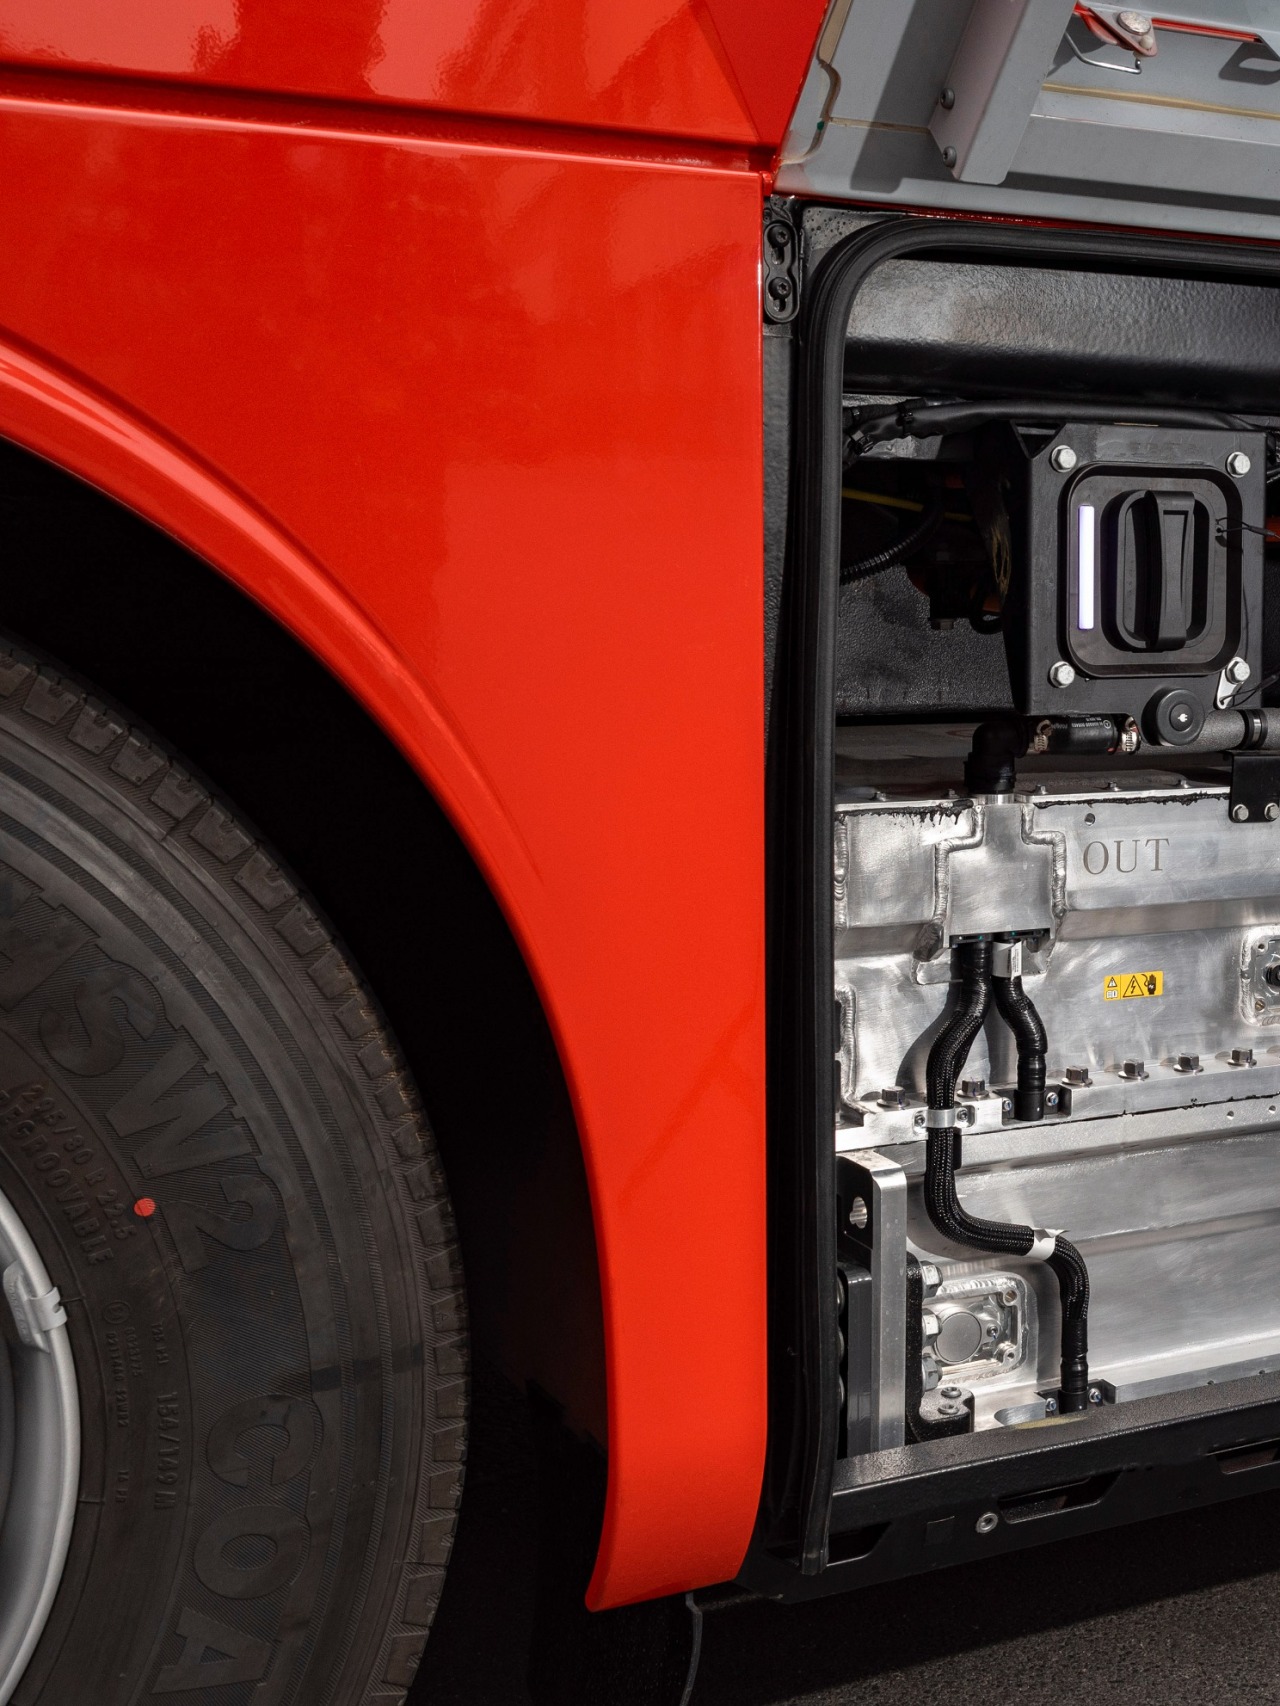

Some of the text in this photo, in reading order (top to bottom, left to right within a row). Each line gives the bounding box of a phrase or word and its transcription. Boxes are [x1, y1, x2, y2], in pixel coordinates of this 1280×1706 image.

[1083, 838, 1170, 875] OUT
[156, 1392, 180, 1486] 154/149
[150, 1393, 317, 1694] COA
